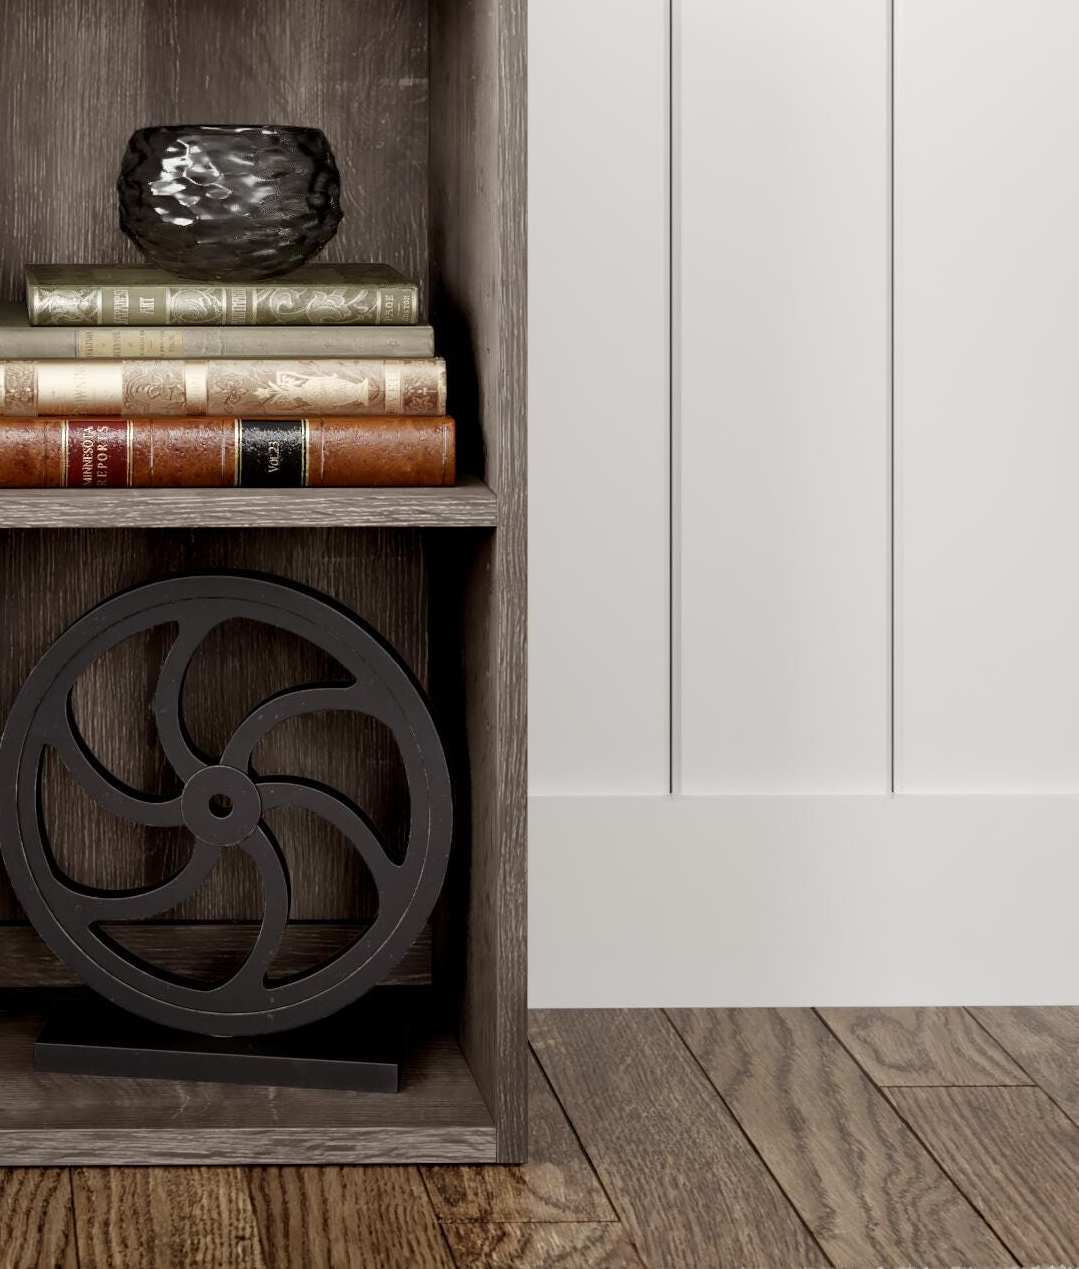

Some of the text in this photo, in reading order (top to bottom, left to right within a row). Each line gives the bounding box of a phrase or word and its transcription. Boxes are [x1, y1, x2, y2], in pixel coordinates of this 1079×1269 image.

[139, 296, 155, 315] ART
[82, 425, 94, 486] MINNESOTA
[96, 425, 108, 486] REPORTS
